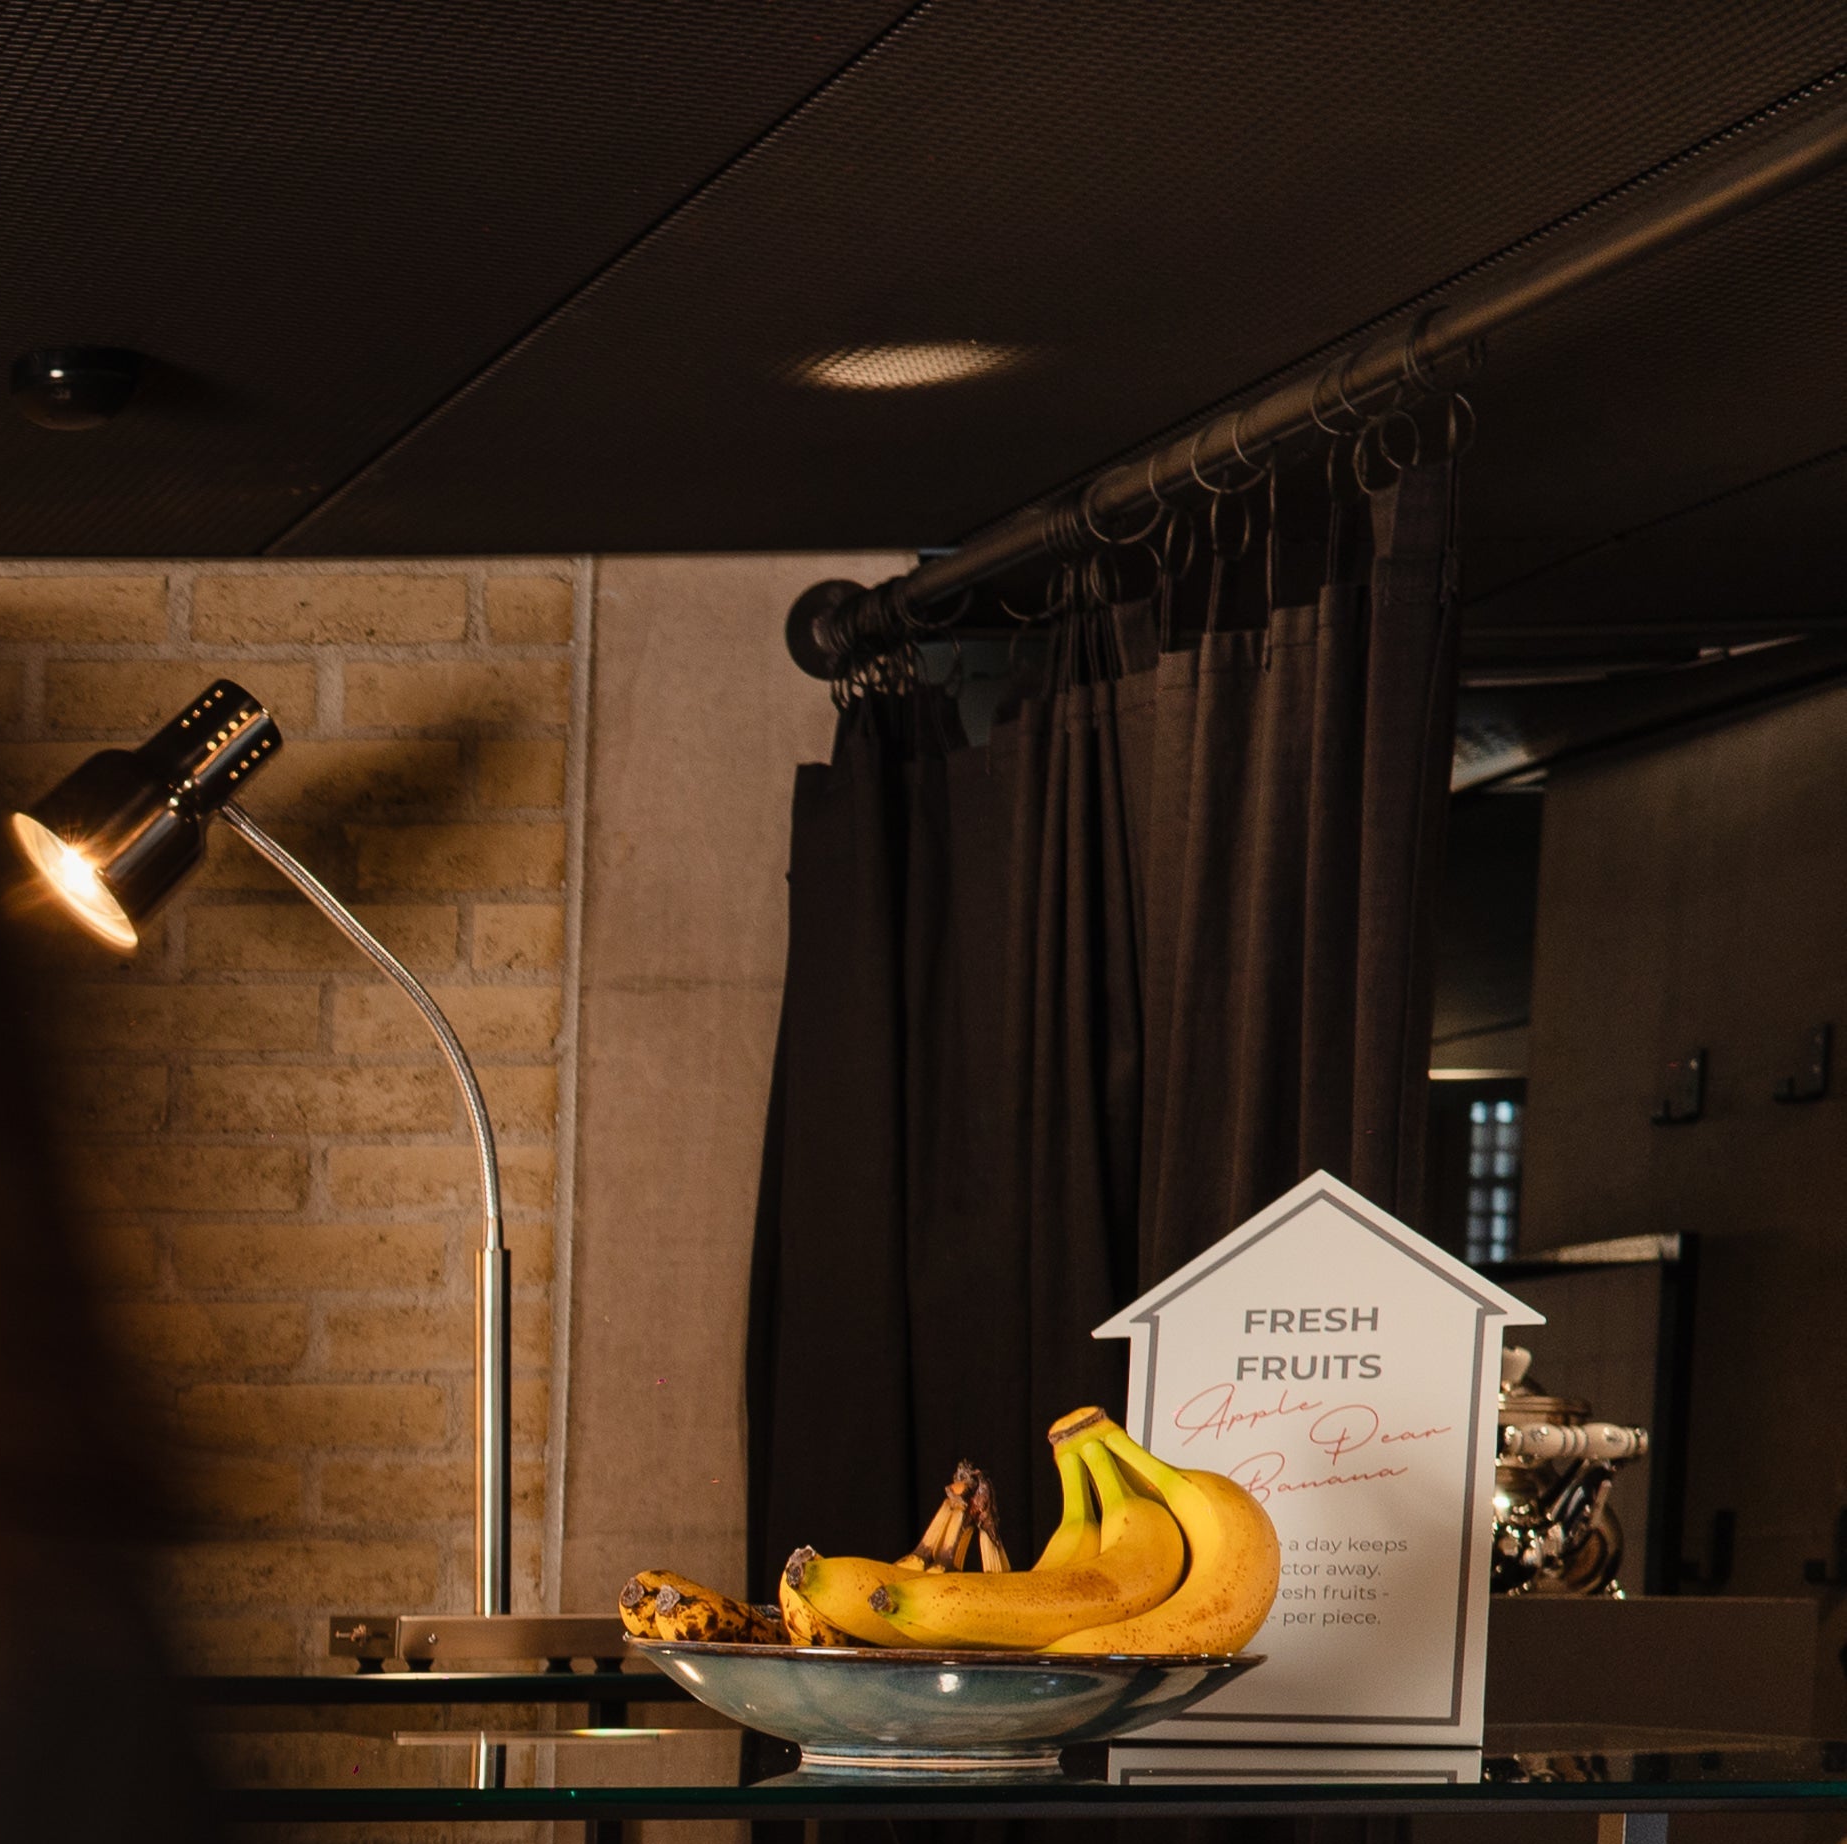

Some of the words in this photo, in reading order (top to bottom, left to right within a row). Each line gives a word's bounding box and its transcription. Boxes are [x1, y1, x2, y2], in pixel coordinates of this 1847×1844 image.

[1243, 1307, 1380, 1334] FRESH
[1236, 1354, 1383, 1381] FRUITS
[1174, 1383, 1323, 1446] Apple
[1227, 1451, 1408, 1504] Banana
[1288, 1539, 1300, 1551] a
[1305, 1537, 1343, 1555] day
[1348, 1536, 1408, 1555] keeps
[1281, 1563, 1320, 1576] ctor
[1326, 1563, 1382, 1580] away.
[1276, 1585, 1316, 1600] resh
[1323, 1584, 1377, 1600] fruits
[1283, 1612, 1316, 1626] per
[1322, 1609, 1381, 1626] piece.
